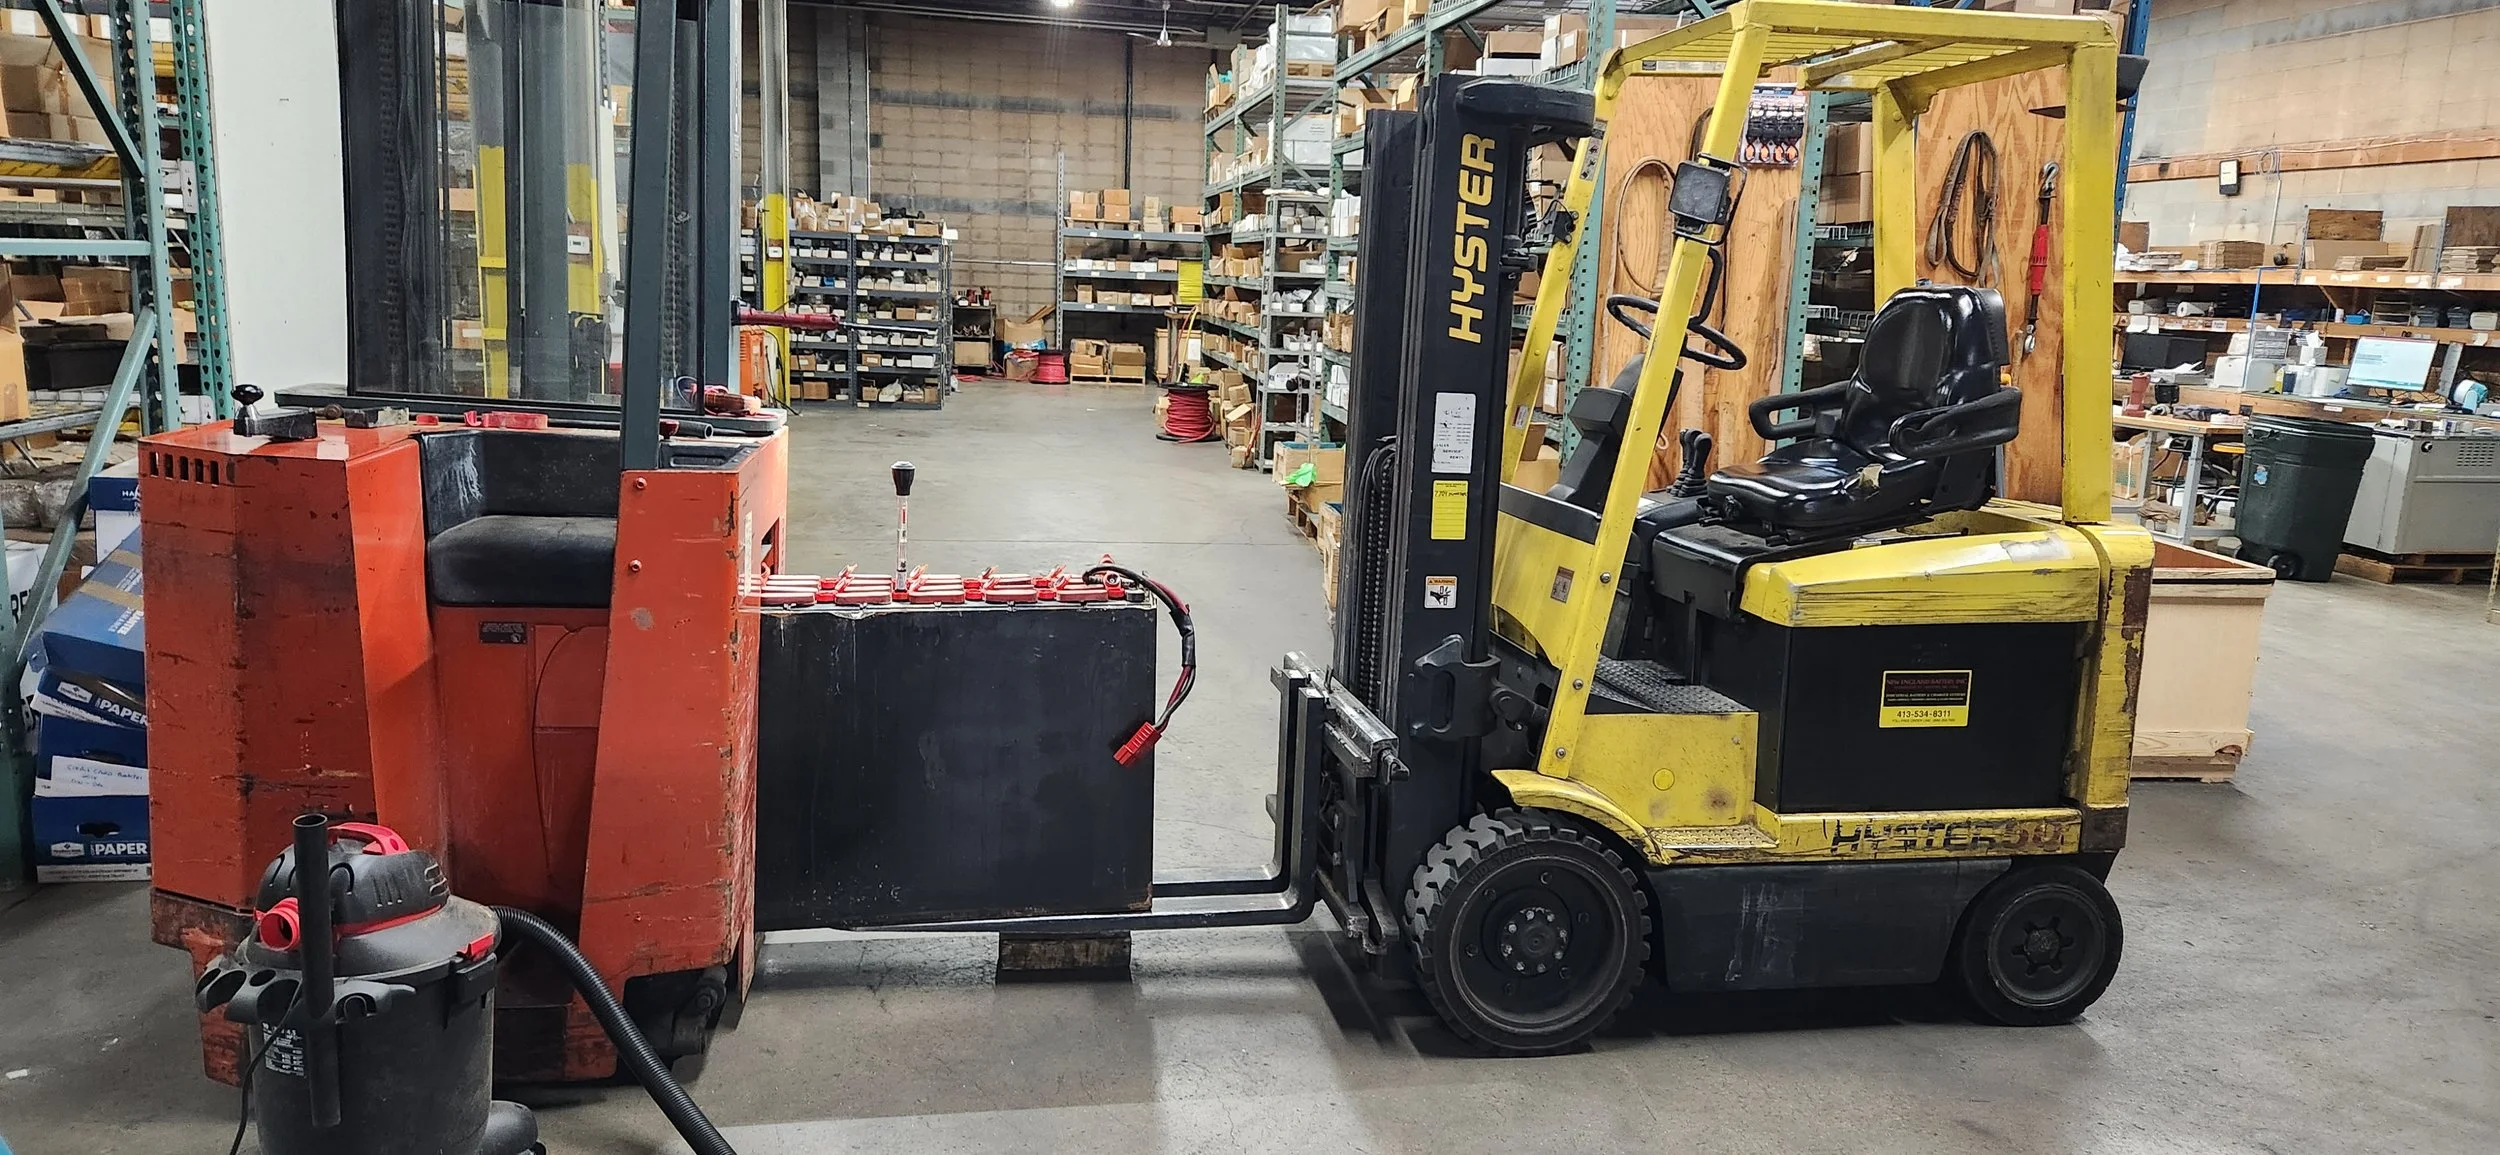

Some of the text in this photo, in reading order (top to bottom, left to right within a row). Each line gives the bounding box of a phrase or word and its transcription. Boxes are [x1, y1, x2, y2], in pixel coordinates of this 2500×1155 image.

[1448, 133, 1496, 344] HYSTER
[100, 698, 148, 726] PAPER
[1896, 710, 1951, 718] 413-534-8311
[95, 842, 148, 855] PAPER
[1830, 818, 1997, 854] HYSTER
